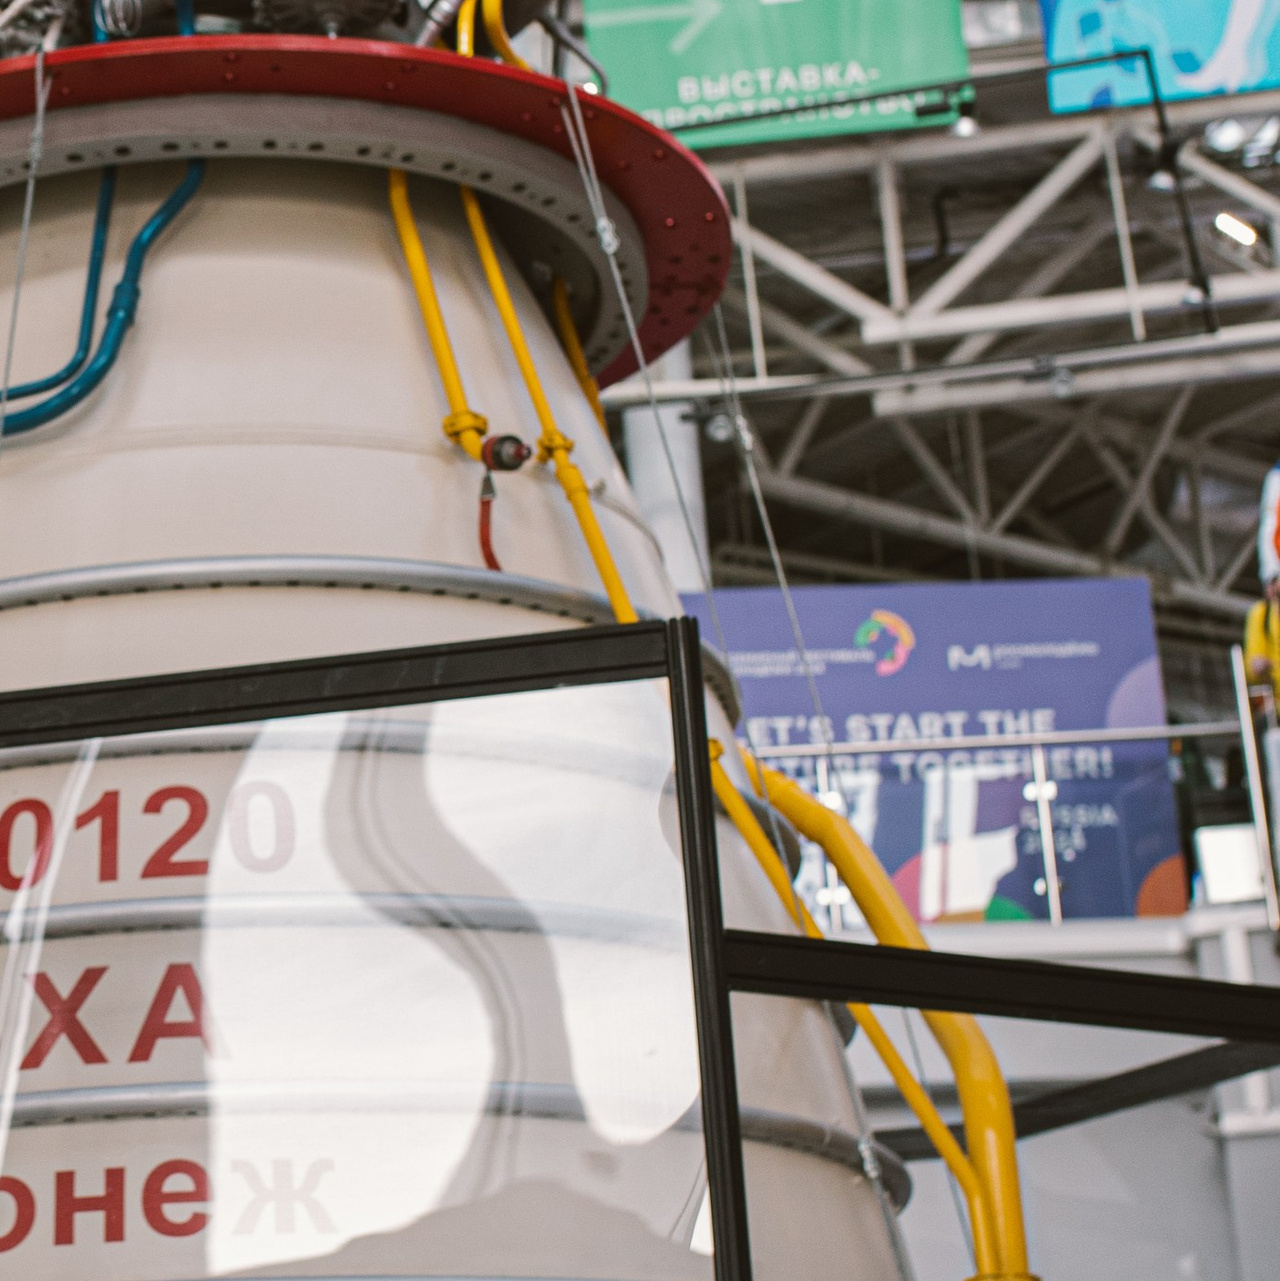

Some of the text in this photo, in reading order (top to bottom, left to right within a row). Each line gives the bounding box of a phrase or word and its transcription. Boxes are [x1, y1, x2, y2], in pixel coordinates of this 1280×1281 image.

[744, 707, 1056, 748] ET'S START THE
